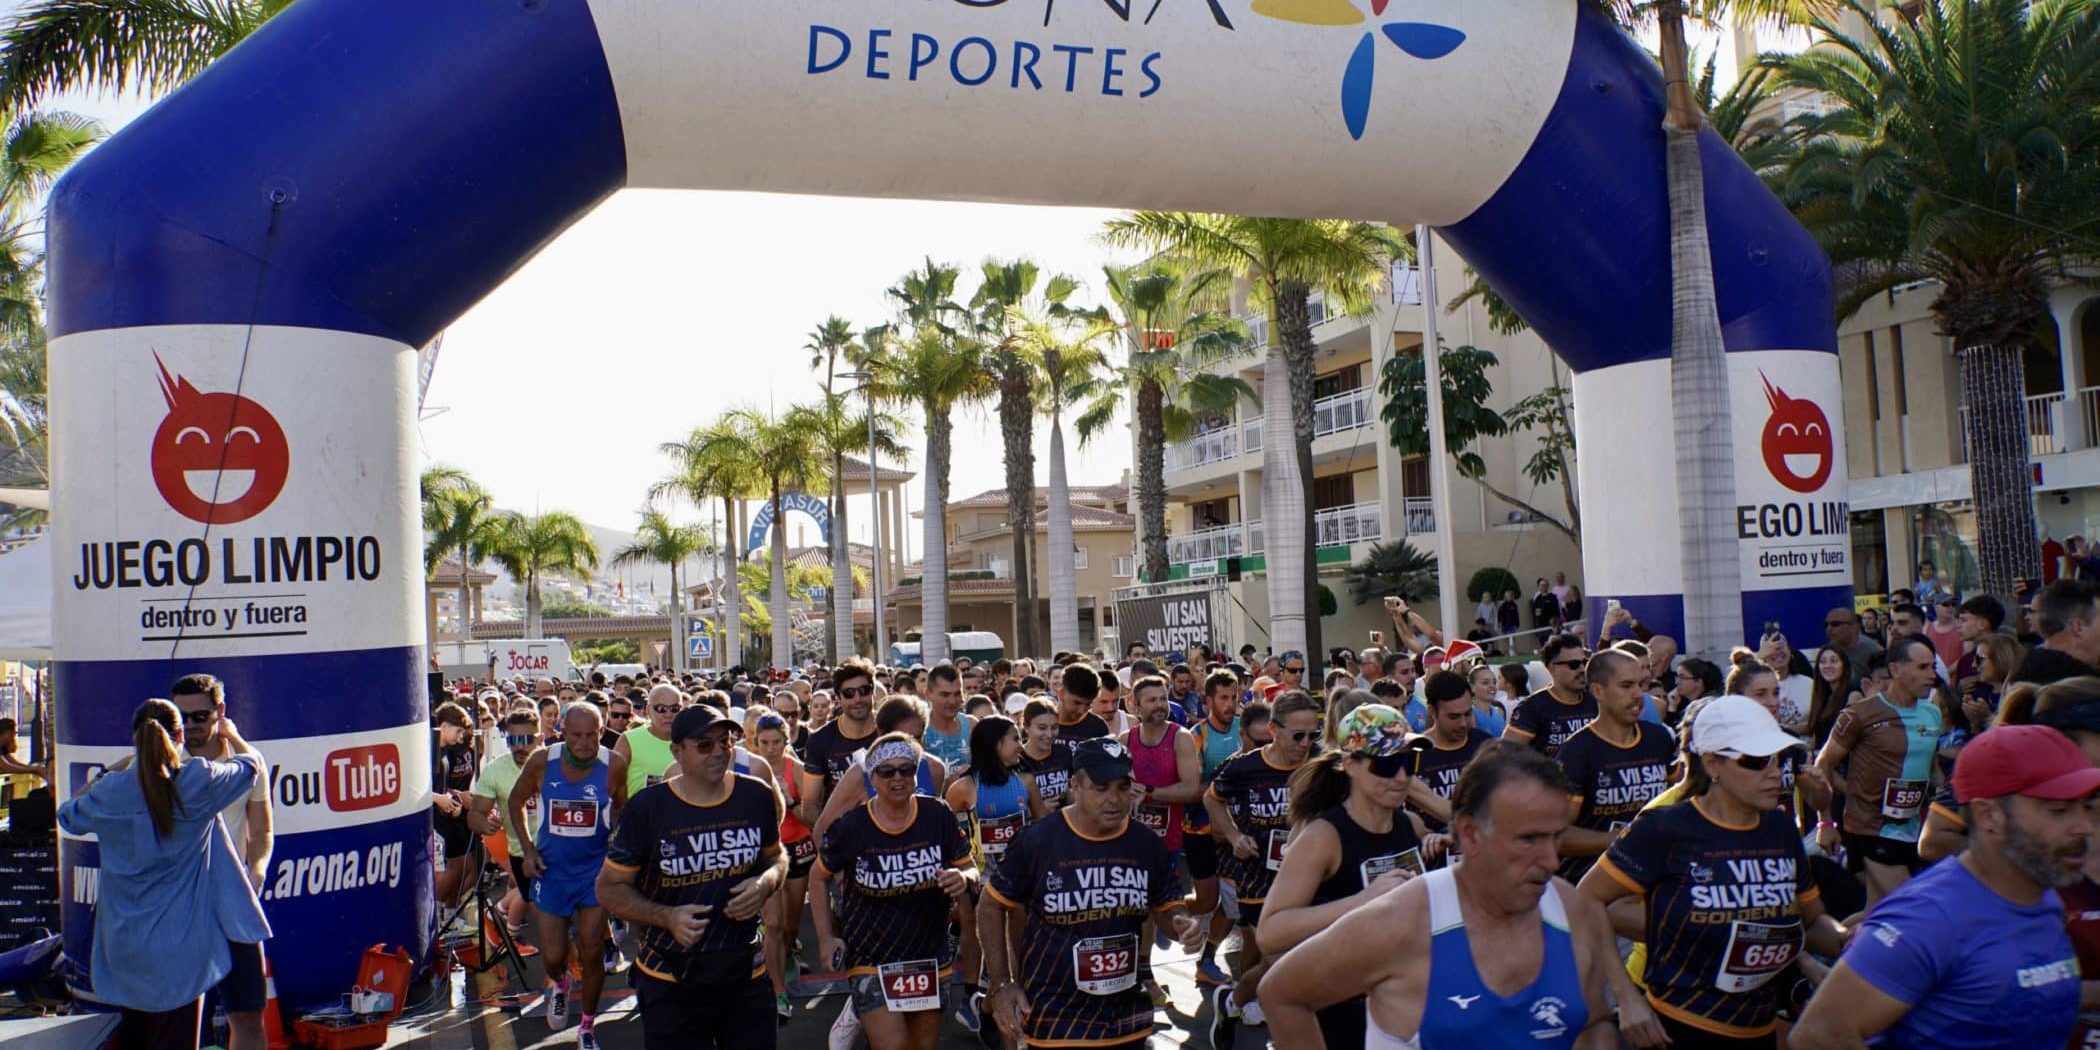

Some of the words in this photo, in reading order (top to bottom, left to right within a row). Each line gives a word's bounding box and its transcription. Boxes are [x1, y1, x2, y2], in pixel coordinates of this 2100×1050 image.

[807, 25, 1161, 98] DEPORTES
[753, 492, 829, 530] VISASUR
[1737, 503, 1802, 539] EGO
[73, 538, 211, 590] JUEGO
[222, 535, 381, 584] LIMPIO
[1759, 550, 1807, 568] dentro
[1811, 551, 1818, 569] y
[1821, 548, 1844, 565] fuera
[141, 606, 216, 628] dentro
[224, 608, 238, 630] y
[246, 602, 307, 625] fuera
[1162, 601, 1179, 626] VII
[1181, 599, 1207, 625] SAN
[693, 621, 702, 631] P
[507, 654, 548, 671] JOCAR
[1619, 767, 1641, 785] VII
[1595, 781, 1668, 805] SILVESTR
[1896, 790, 1923, 804] 559
[564, 810, 584, 823] 16
[688, 832, 718, 853] VII
[721, 827, 761, 849] SAN
[794, 840, 814, 856] 513
[259, 841, 403, 897] .arona.org
[878, 853, 903, 872] VII
[906, 845, 942, 868] SAN
[1075, 867, 1105, 888] VII
[1110, 866, 1148, 889] SAN
[1727, 859, 1763, 882] VII
[1043, 888, 1148, 913] SILVESTRE
[1690, 906, 1776, 924] GOLDEN
[1090, 951, 1128, 973] 332
[1744, 943, 1792, 966] 658
[892, 974, 929, 992] 419
